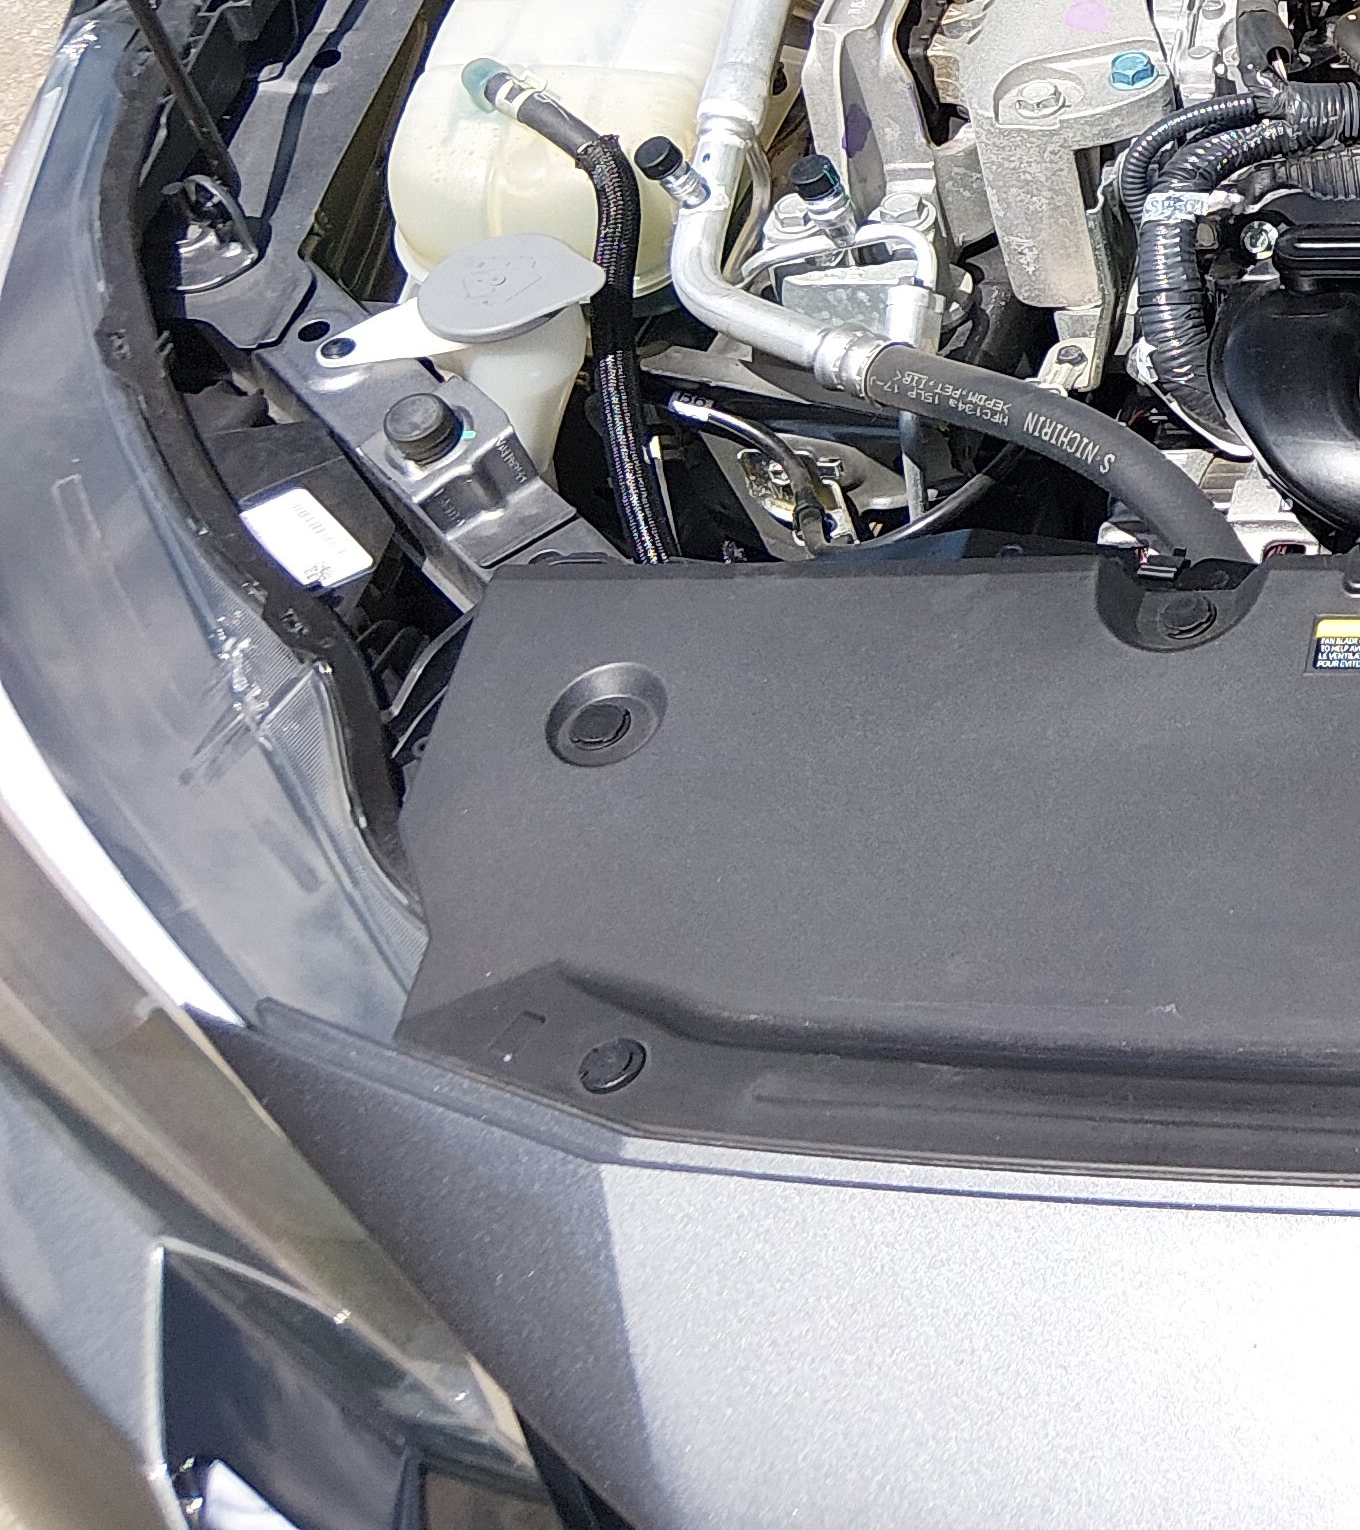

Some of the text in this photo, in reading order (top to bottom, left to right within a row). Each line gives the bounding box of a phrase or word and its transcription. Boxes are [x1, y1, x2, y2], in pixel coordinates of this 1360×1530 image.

[949, 399, 1009, 426] HFC134a
[1320, 637, 1335, 645] FAN
[1316, 660, 1339, 668] POUR
